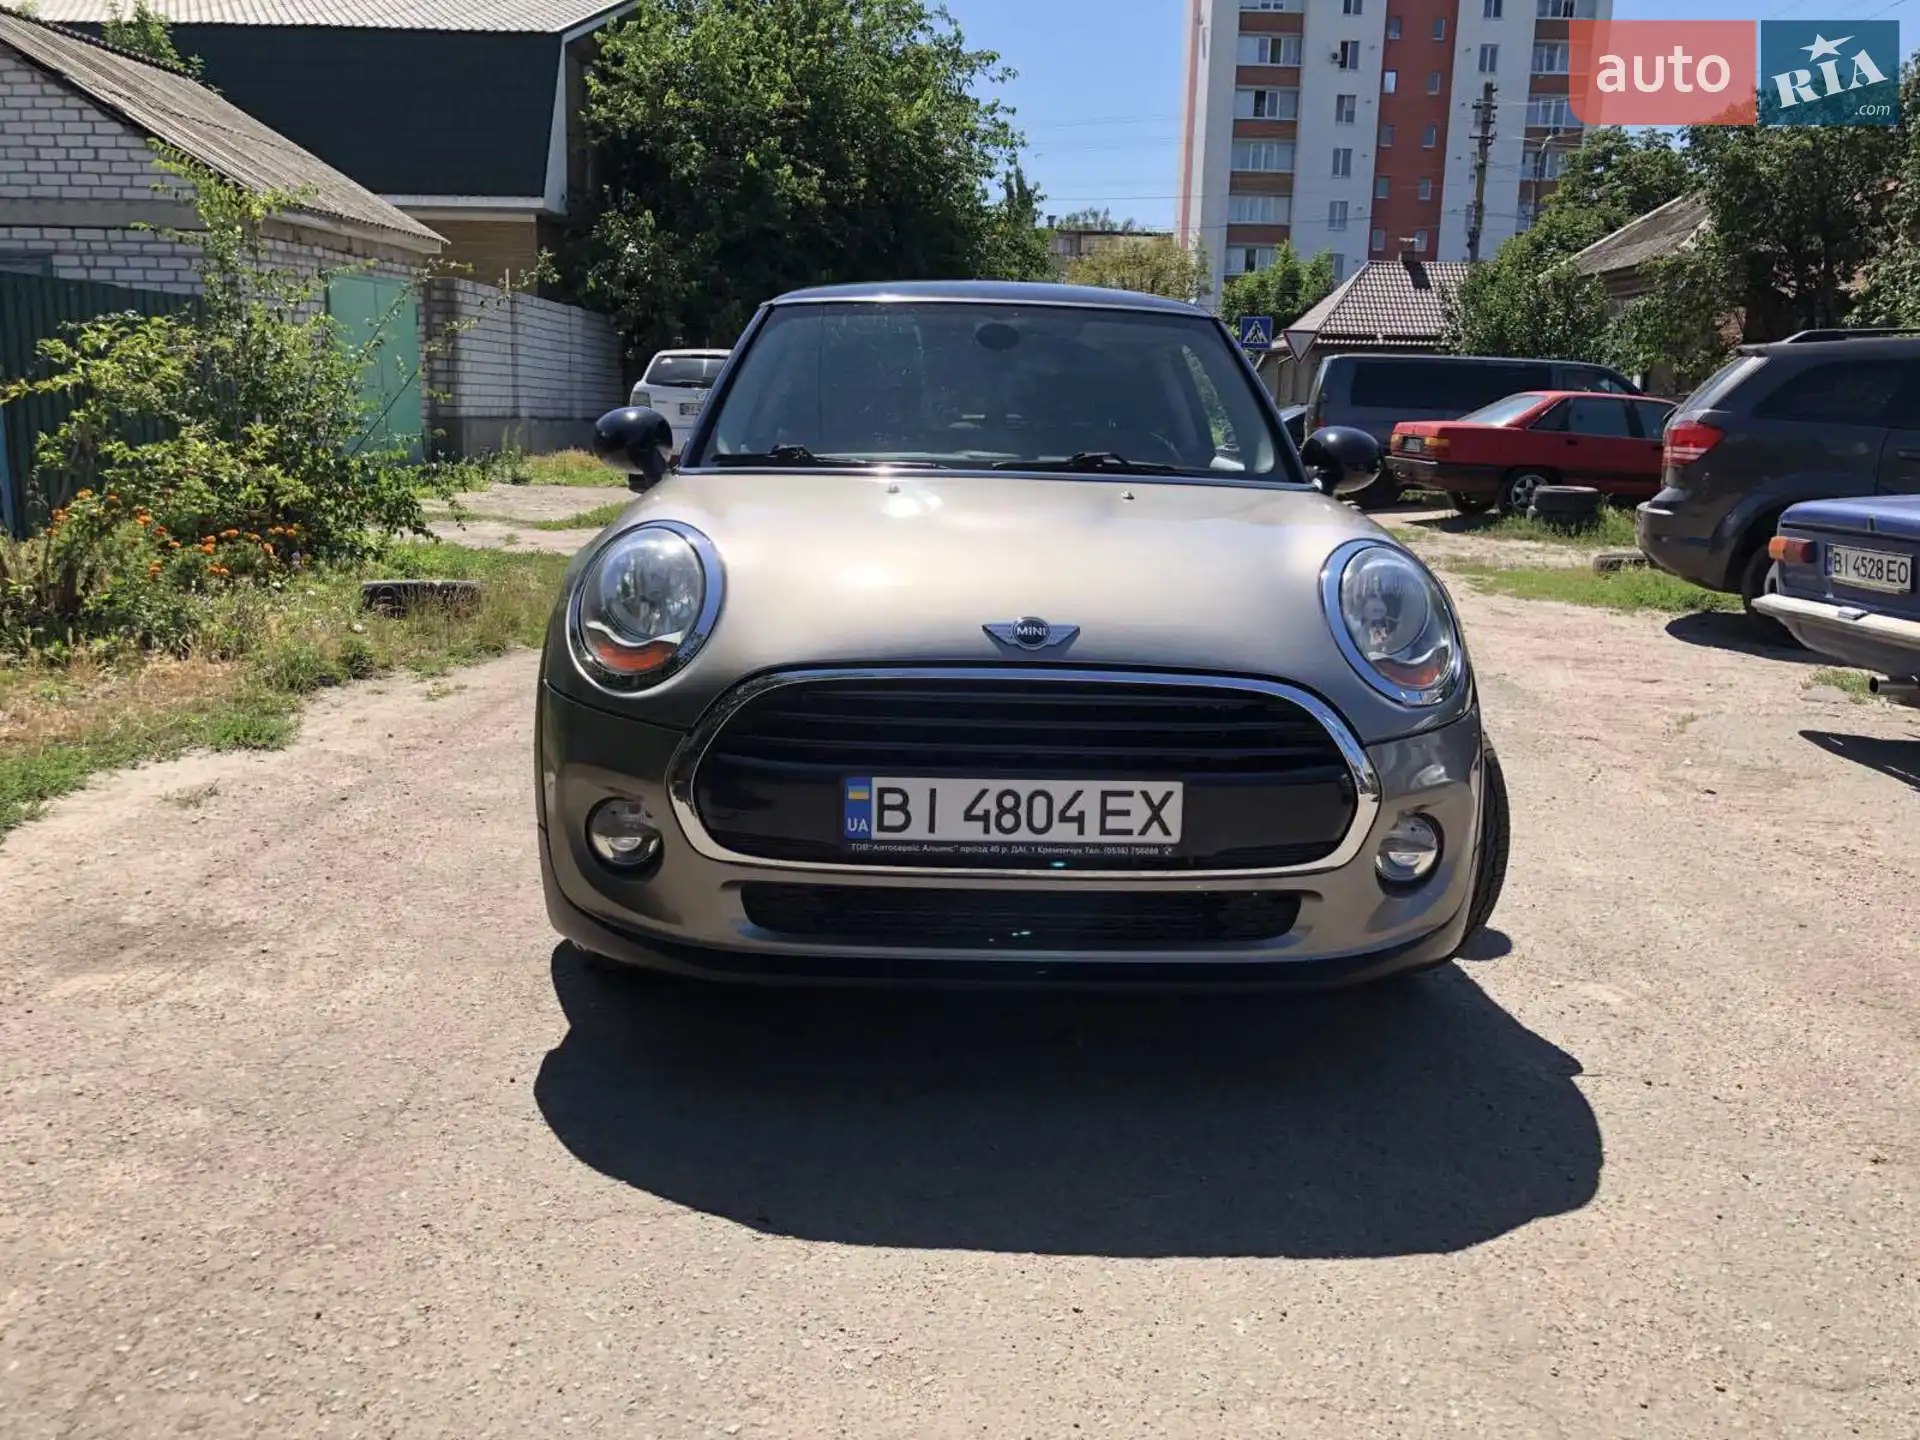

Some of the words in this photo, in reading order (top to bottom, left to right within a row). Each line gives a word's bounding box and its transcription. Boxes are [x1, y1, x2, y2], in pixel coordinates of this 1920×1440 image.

[1833, 552, 1849, 577] BI
[1016, 626, 1047, 636] MINI
[876, 786, 937, 834] BI
[847, 817, 869, 832] UA
